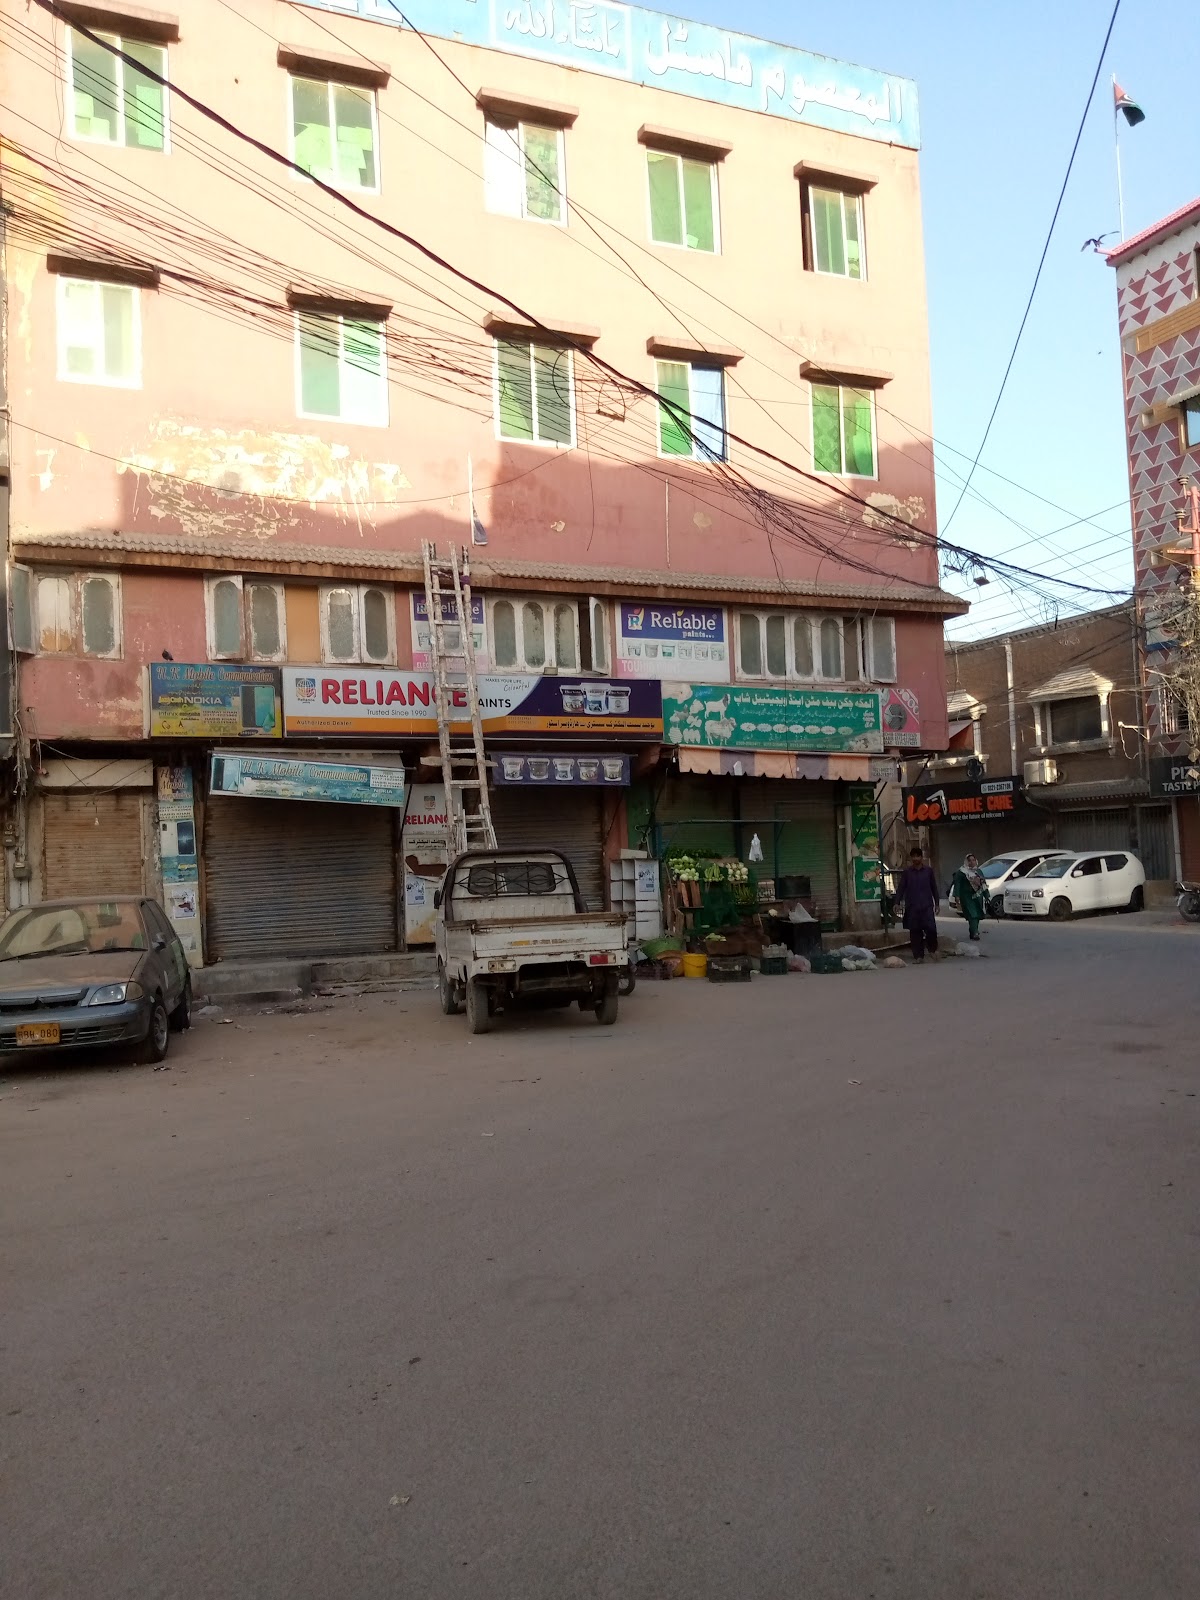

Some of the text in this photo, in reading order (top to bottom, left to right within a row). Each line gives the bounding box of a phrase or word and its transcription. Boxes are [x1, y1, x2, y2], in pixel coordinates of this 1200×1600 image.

[650, 611, 716, 631] Reliable
[183, 667, 214, 682] Mobile
[218, 668, 274, 683] Communication
[184, 697, 222, 705] NOKIA
[478, 698, 511, 708] AINTS
[269, 763, 303, 777] Mobile
[309, 765, 368, 783] Communication
[1171, 765, 1200, 780] PI
[1162, 782, 1192, 792] TASTE
[906, 795, 942, 822] Lee
[948, 794, 1014, 814] MOBILE CARE
[405, 814, 448, 825] RELIAN
